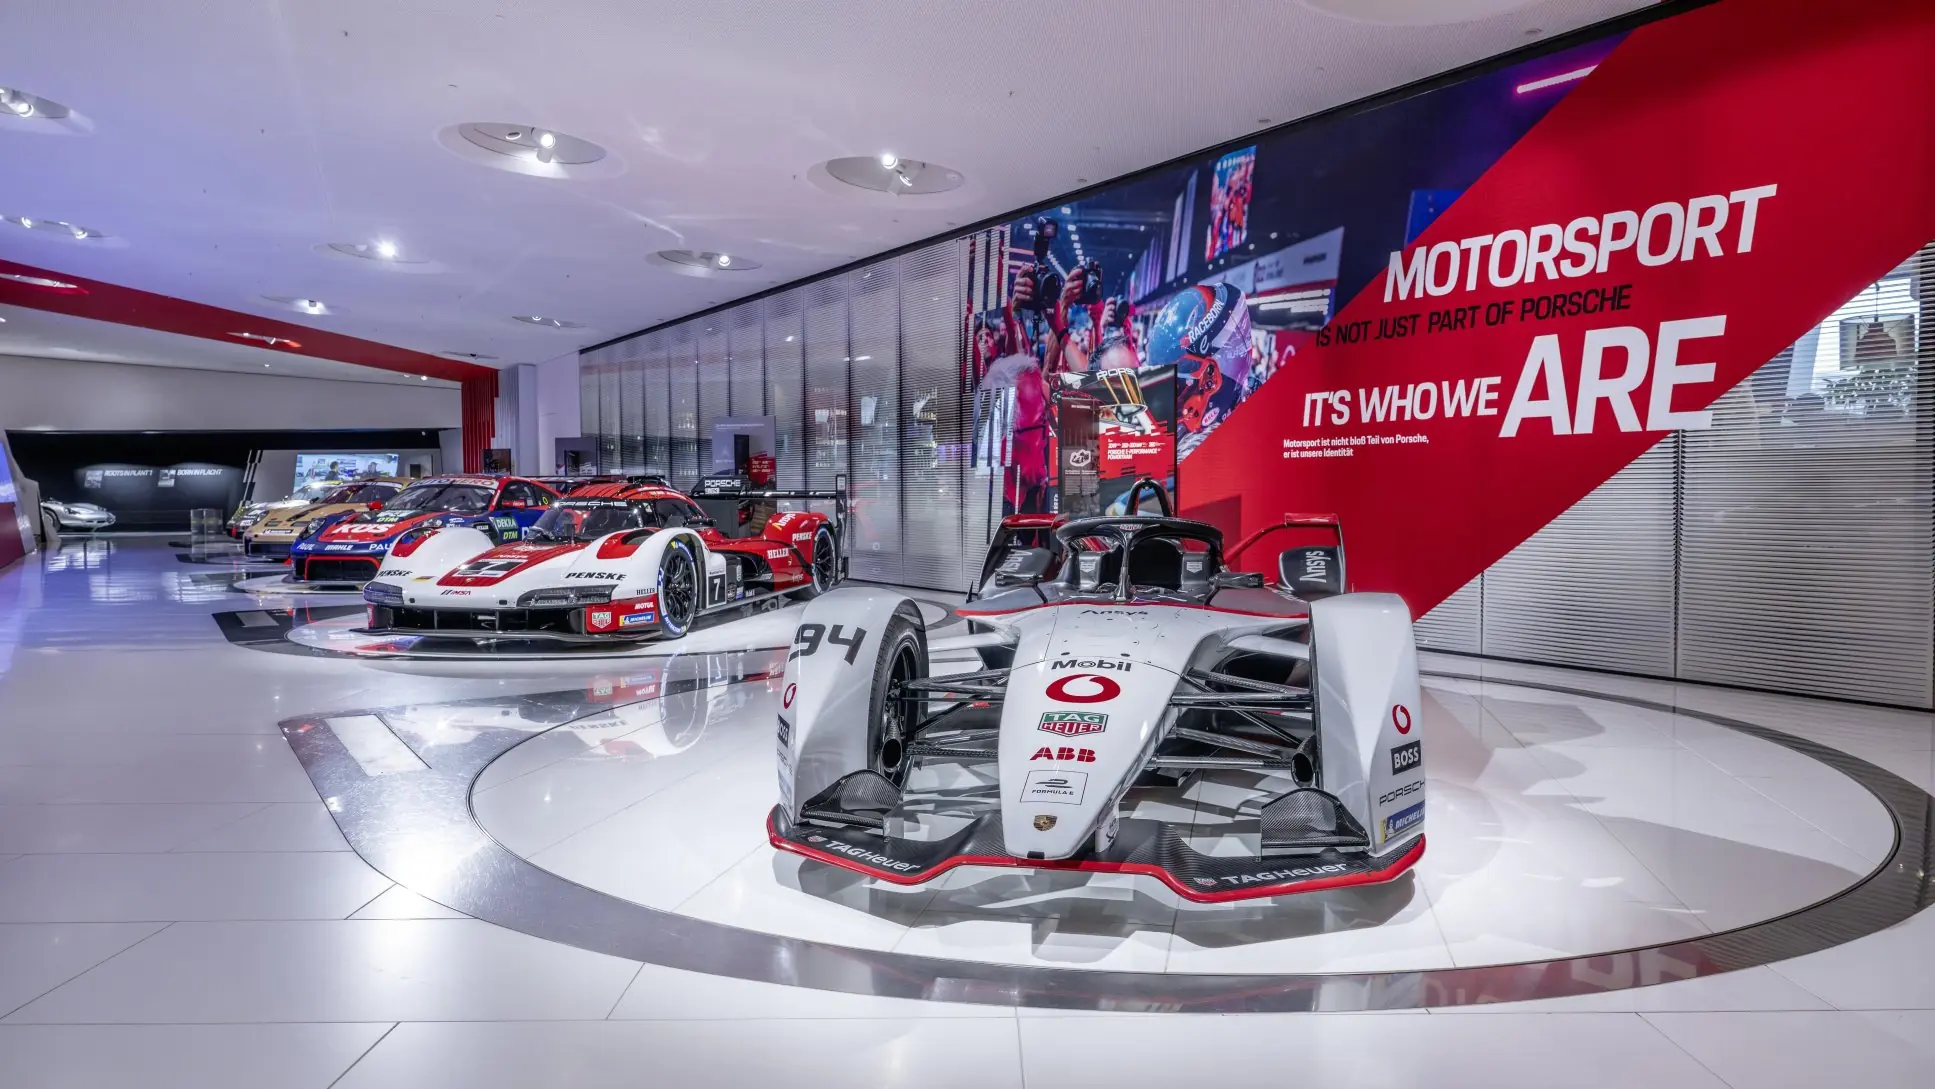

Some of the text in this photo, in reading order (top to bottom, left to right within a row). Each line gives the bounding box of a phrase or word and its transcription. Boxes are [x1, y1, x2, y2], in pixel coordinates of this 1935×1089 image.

[1383, 183, 1778, 302] MOTORSPORT
[1188, 299, 1225, 343] RACEBORN
[1316, 284, 1633, 347] IS NOT JUST PART OF PORSCHE
[1302, 314, 1727, 439] IT'S WHO WE ARE
[1283, 433, 1429, 449] Motorsport ist nicht bloß Teil von Porsche,
[1291, 449, 1299, 458] ist
[1300, 450, 1322, 458] unsere
[1323, 448, 1354, 457] Identität
[705, 479, 741, 487] PORSCHE
[496, 519, 516, 528] DEKRA
[503, 531, 517, 540] DTM
[792, 532, 813, 541] PENSKE
[767, 548, 790, 559] HELLER
[1299, 550, 1332, 583] Ansys
[565, 572, 627, 581] PENSKE
[713, 578, 721, 601] 7
[635, 602, 654, 610] MOTUL
[789, 623, 867, 666] 94
[1051, 659, 1132, 672] Mobil
[1049, 713, 1101, 722] TAG
[1043, 722, 1100, 734] HEUER
[1029, 747, 1096, 762] ABB
[1393, 747, 1419, 769] BOSS
